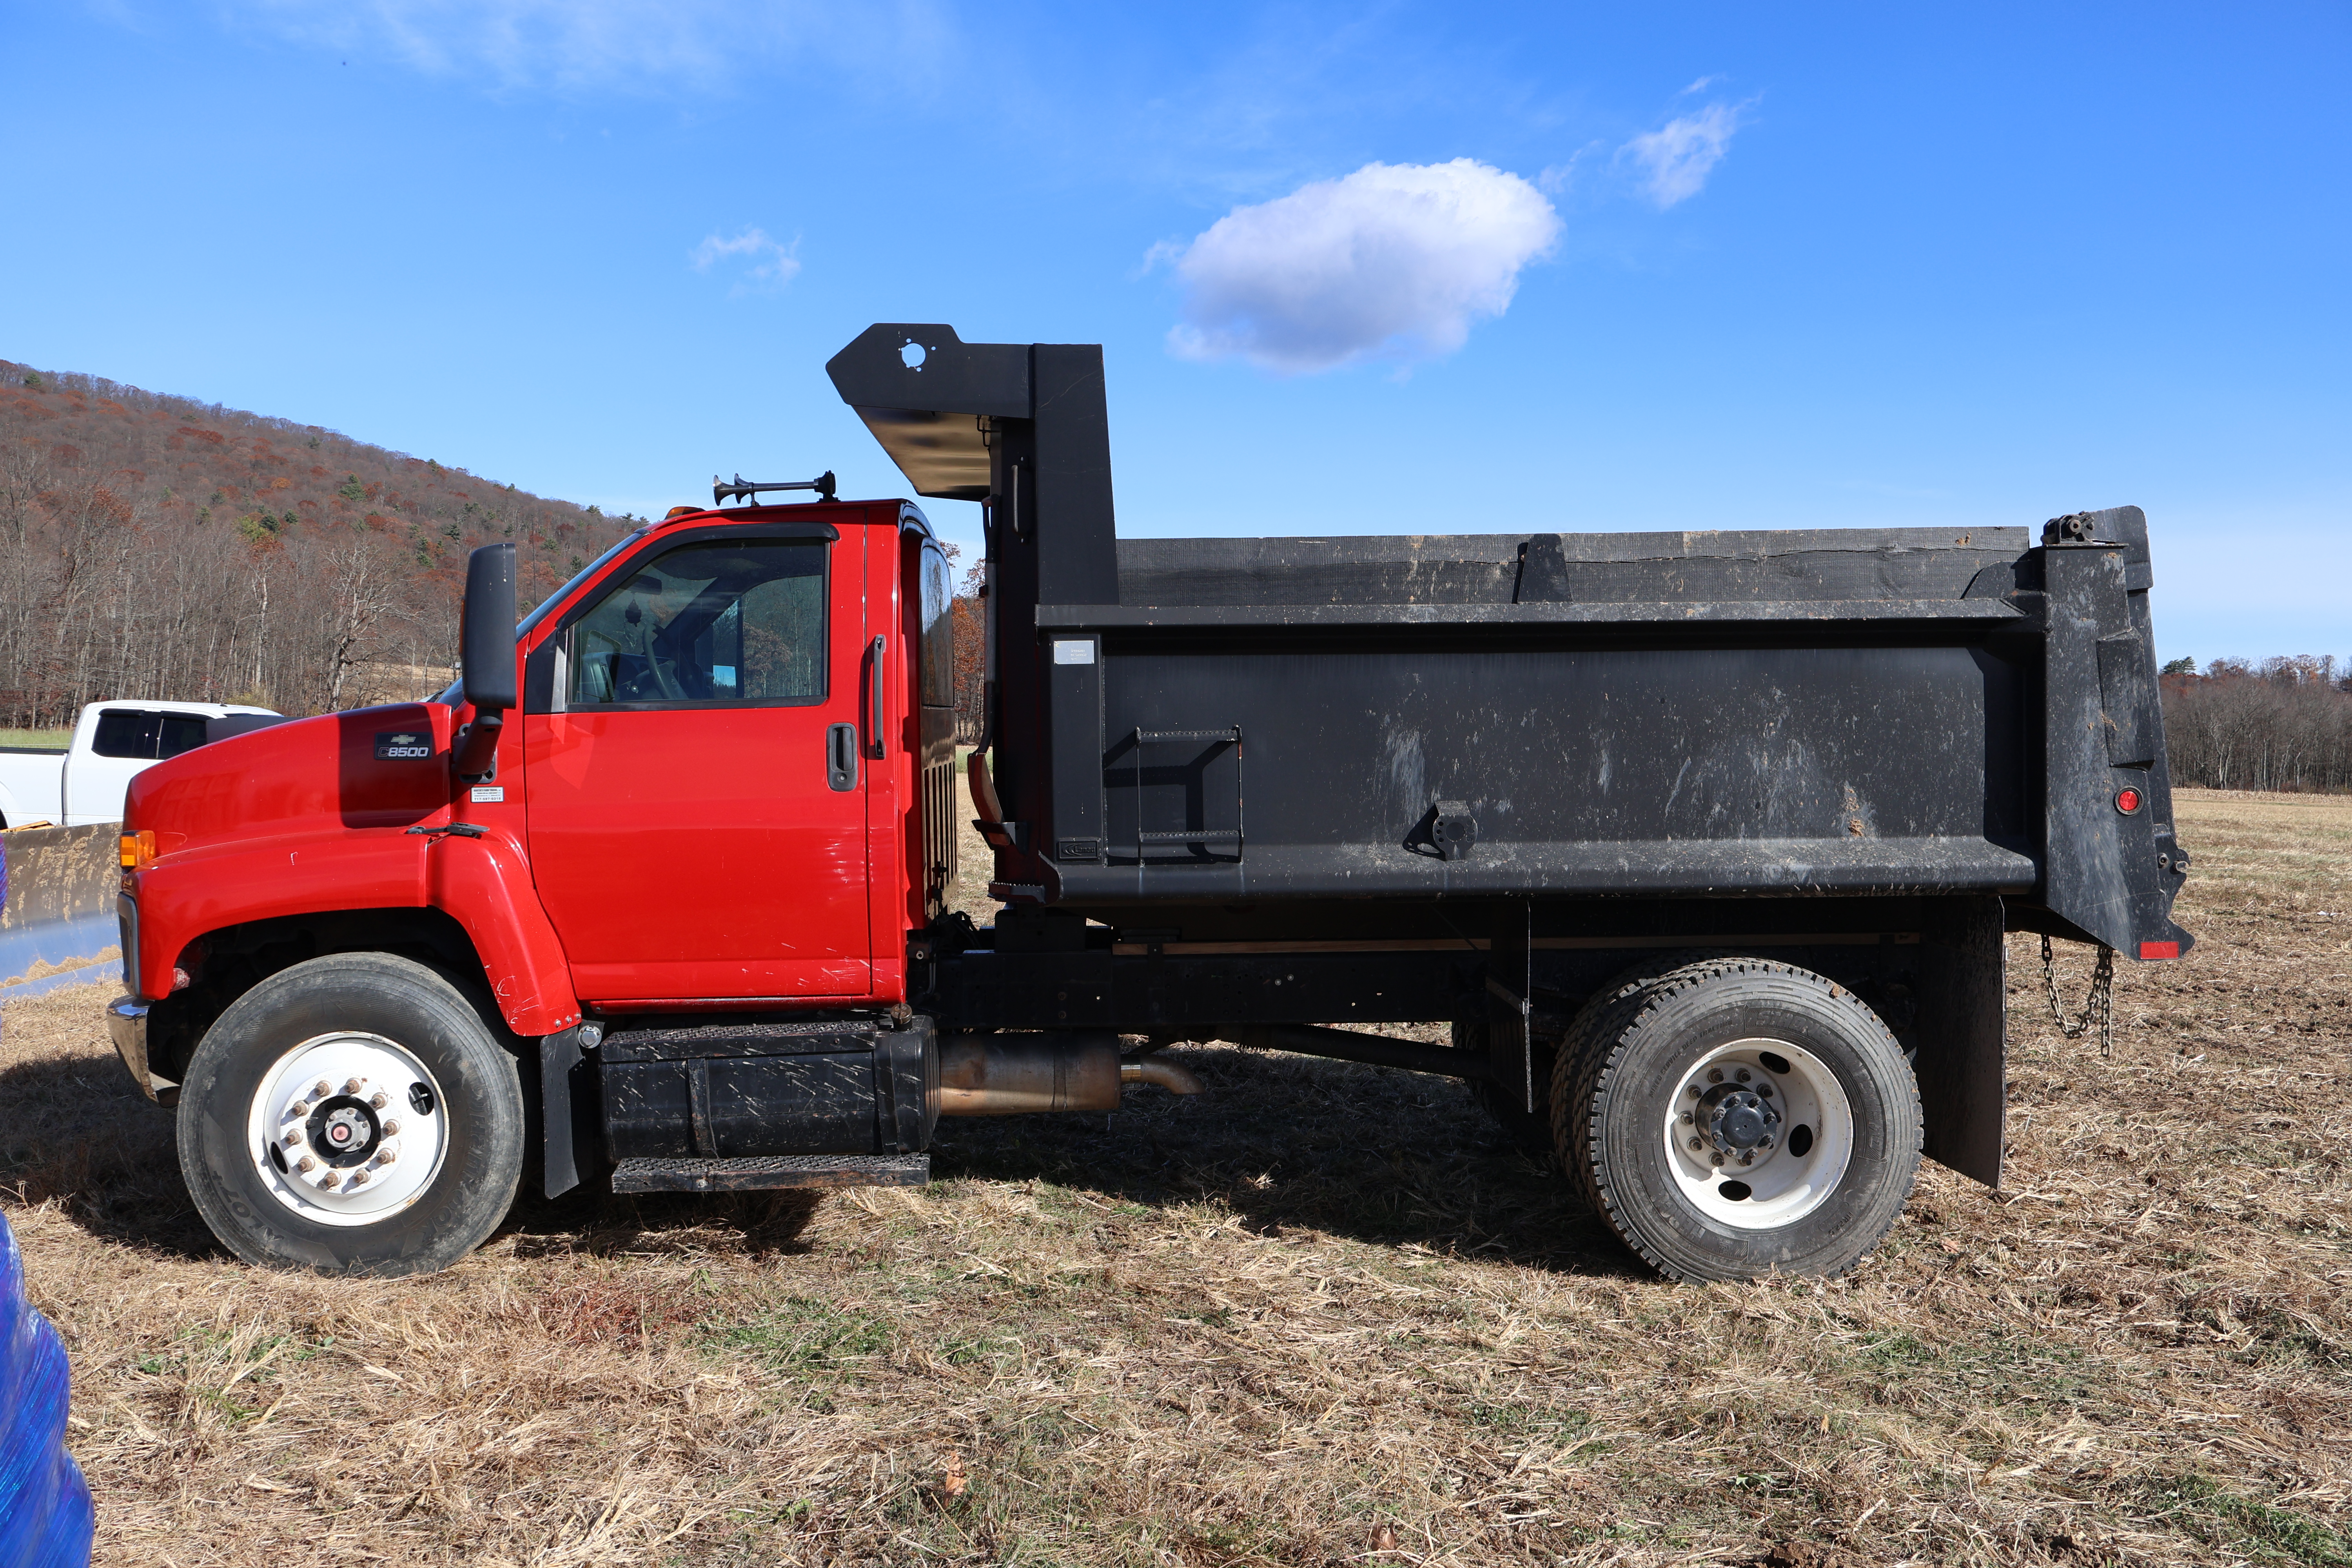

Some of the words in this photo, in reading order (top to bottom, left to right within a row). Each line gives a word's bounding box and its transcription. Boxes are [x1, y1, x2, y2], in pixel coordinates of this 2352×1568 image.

[378, 747, 428, 757] C8500
[1649, 1076, 1662, 1098] MIXED
[1660, 1049, 1682, 1074] SERVICE
[1682, 1035, 1698, 1051] DEEP
[1698, 1019, 1733, 1038] TRACTION
[1828, 1211, 1854, 1236] 11R22.5
